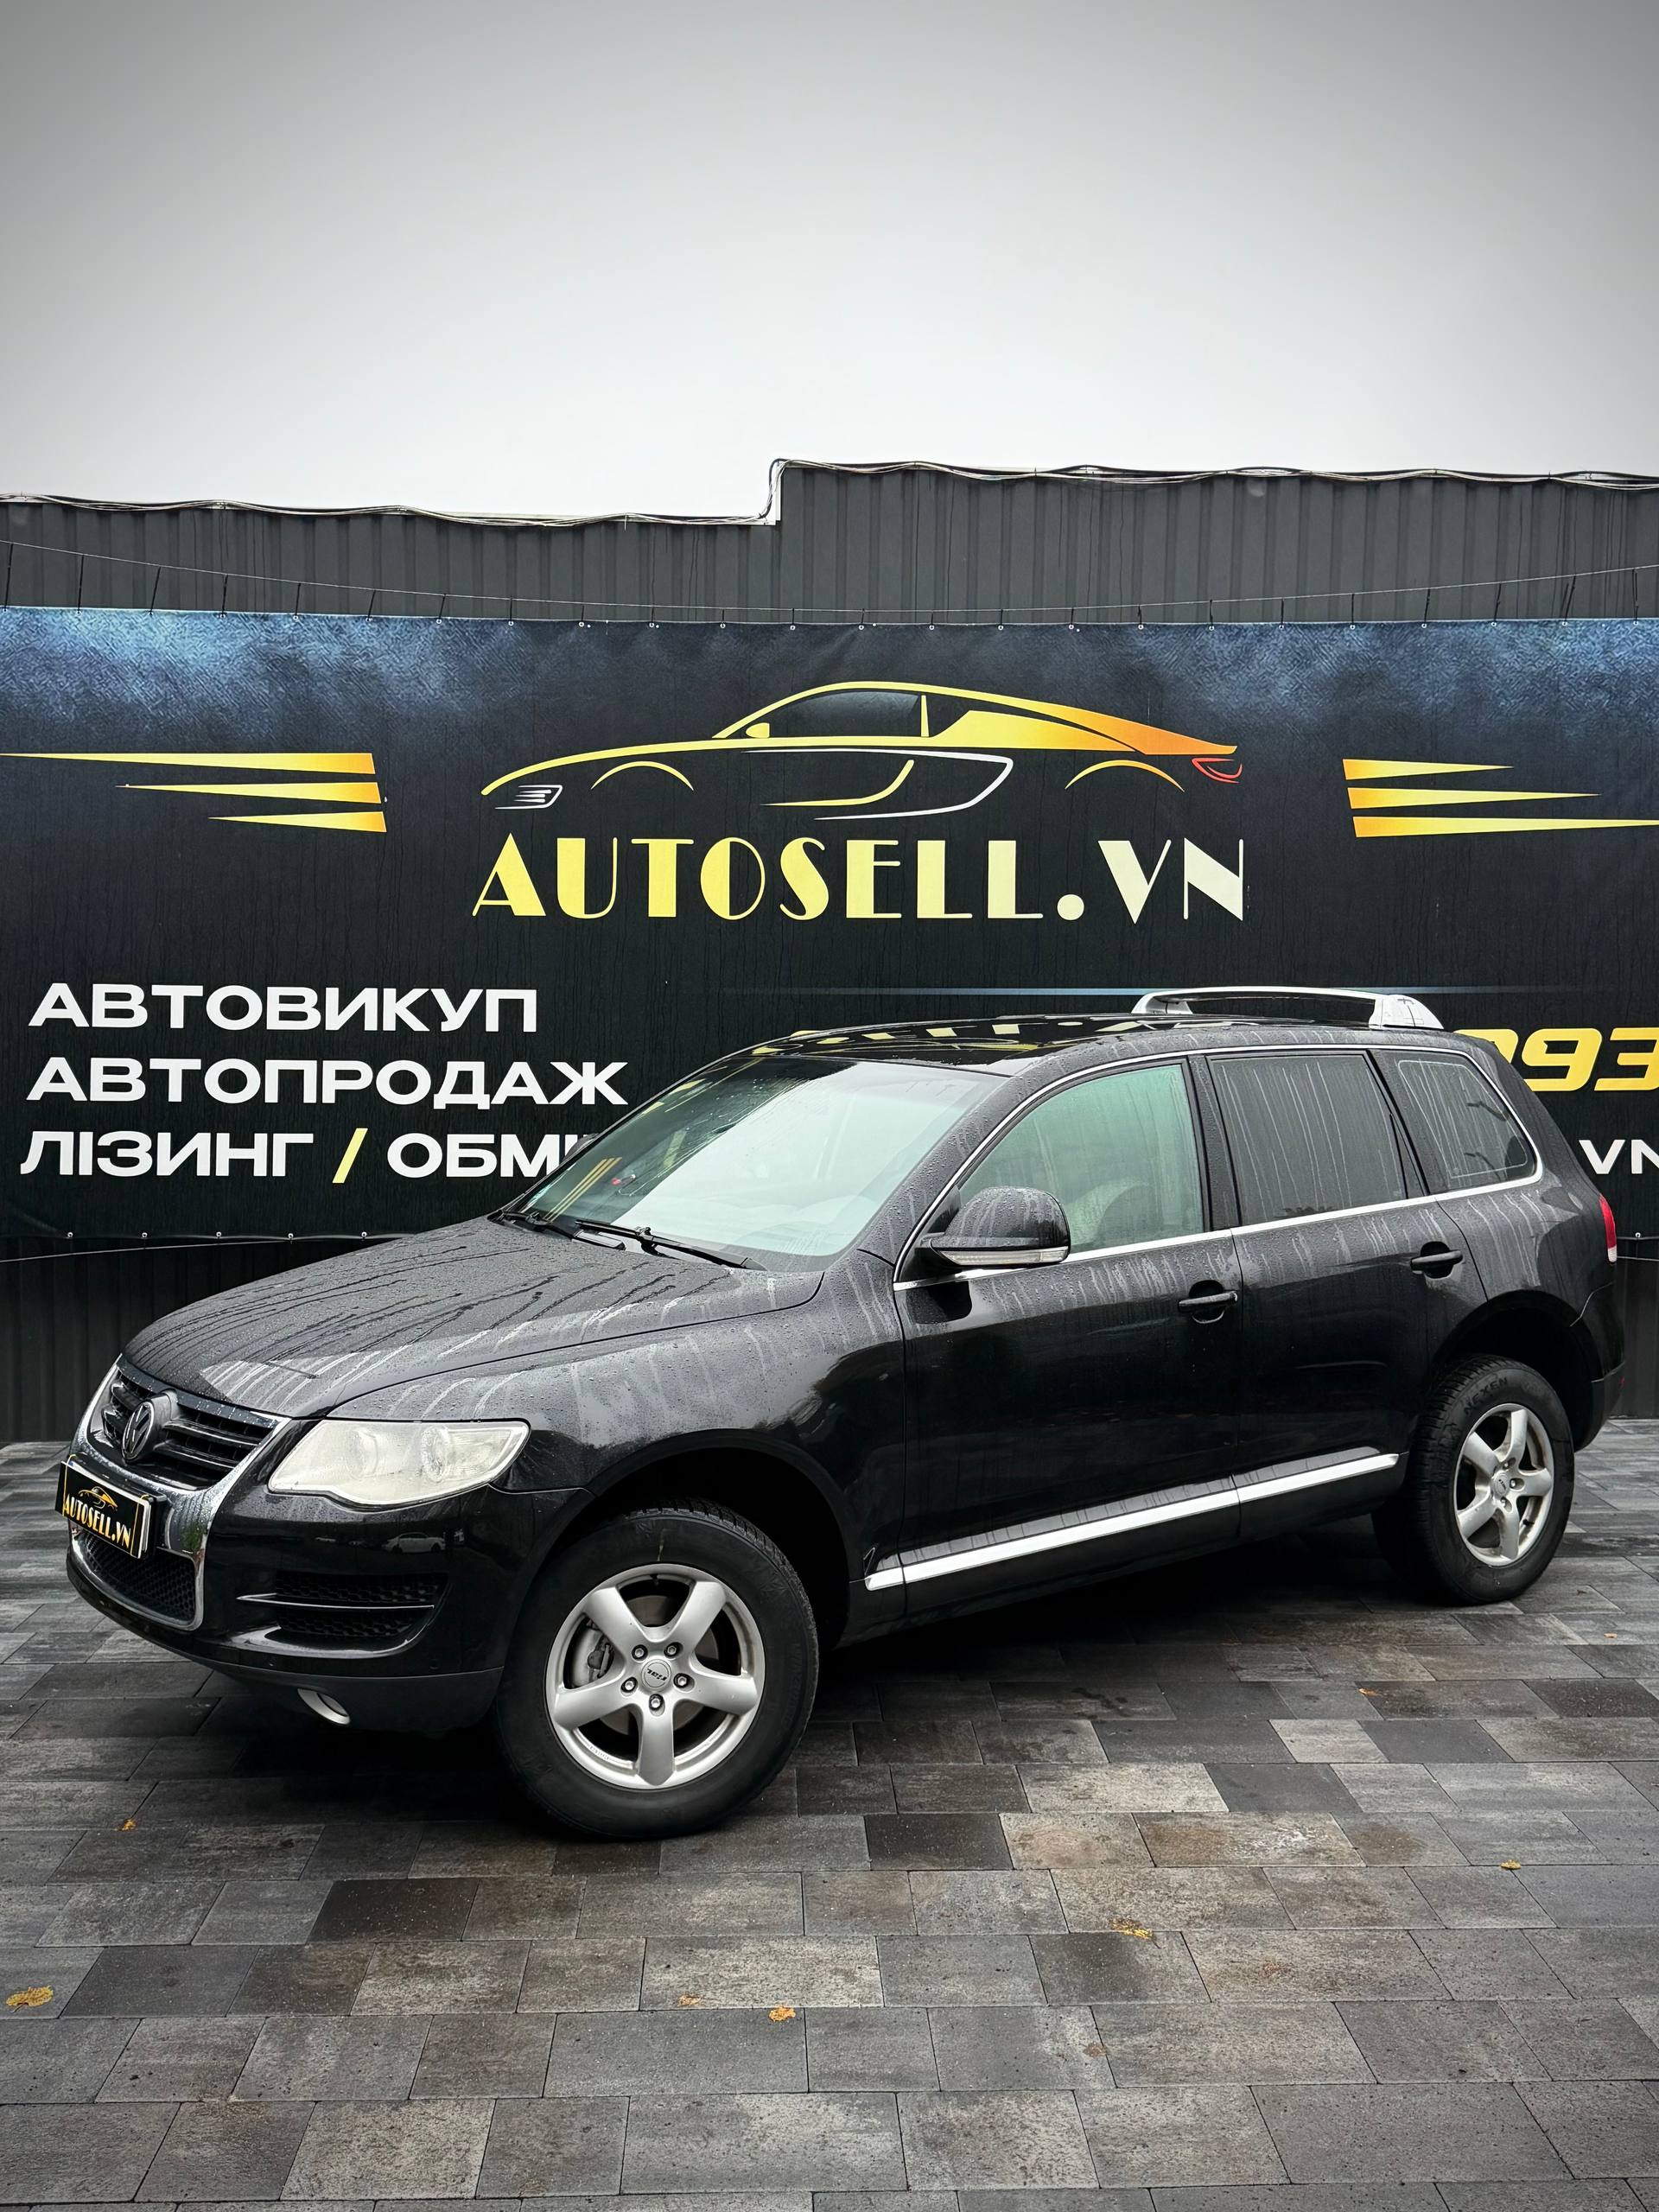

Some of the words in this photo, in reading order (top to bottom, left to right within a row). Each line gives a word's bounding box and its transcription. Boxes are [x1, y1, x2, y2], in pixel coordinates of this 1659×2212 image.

[473, 833, 1244, 925] AUTOSELL.VN
[29, 982, 537, 1033] АВТОВИКУП
[27, 1056, 629, 1109] АВТОПРОДАЖ
[21, 1131, 314, 1177] ЛІЗИНГ
[333, 1128, 368, 1184] /
[387, 1133, 588, 1178] ОБМ
[63, 1494, 131, 1548] AUTOSELL.VN
